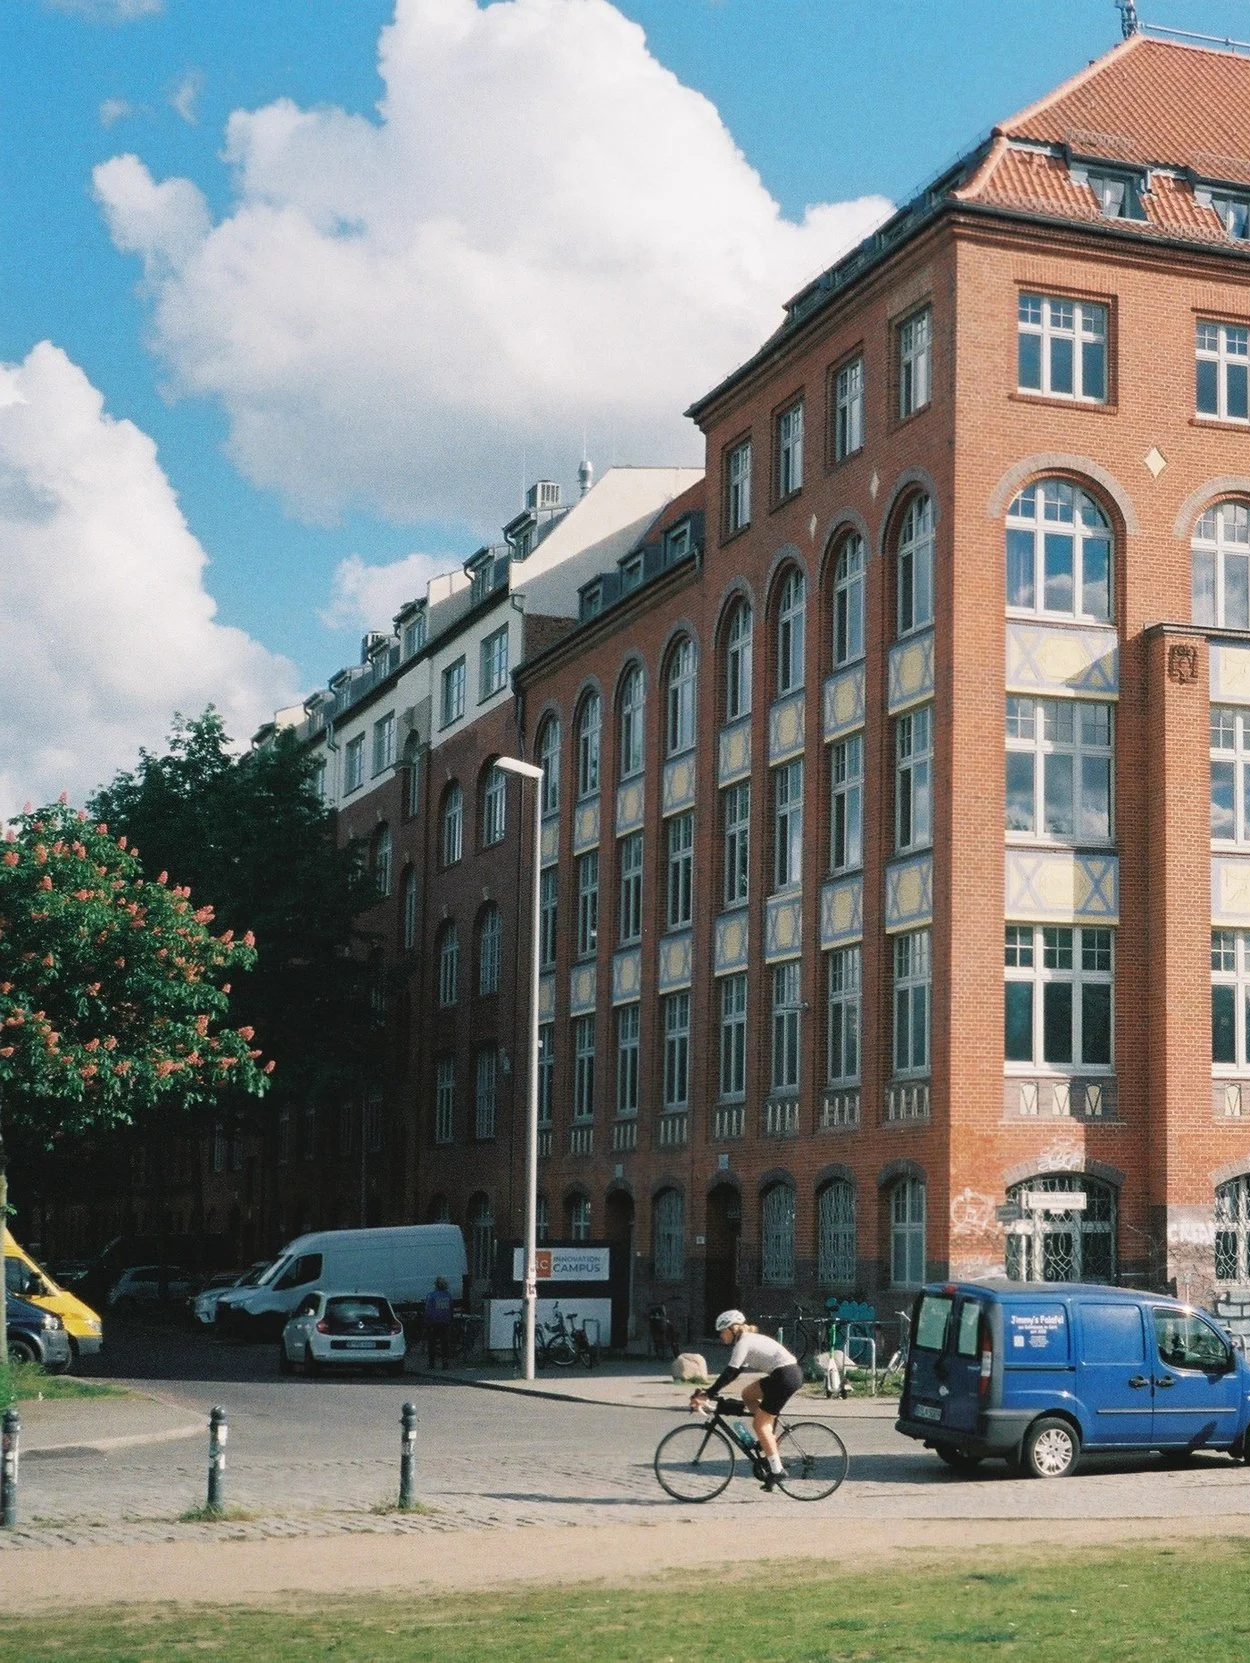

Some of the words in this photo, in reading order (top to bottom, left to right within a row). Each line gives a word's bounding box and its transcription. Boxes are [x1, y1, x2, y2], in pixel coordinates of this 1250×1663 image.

[553, 1264, 600, 1272] CAMPUS
[1011, 1315, 1039, 1325] Jimmy's
[1040, 1315, 1064, 1324] Falafel
